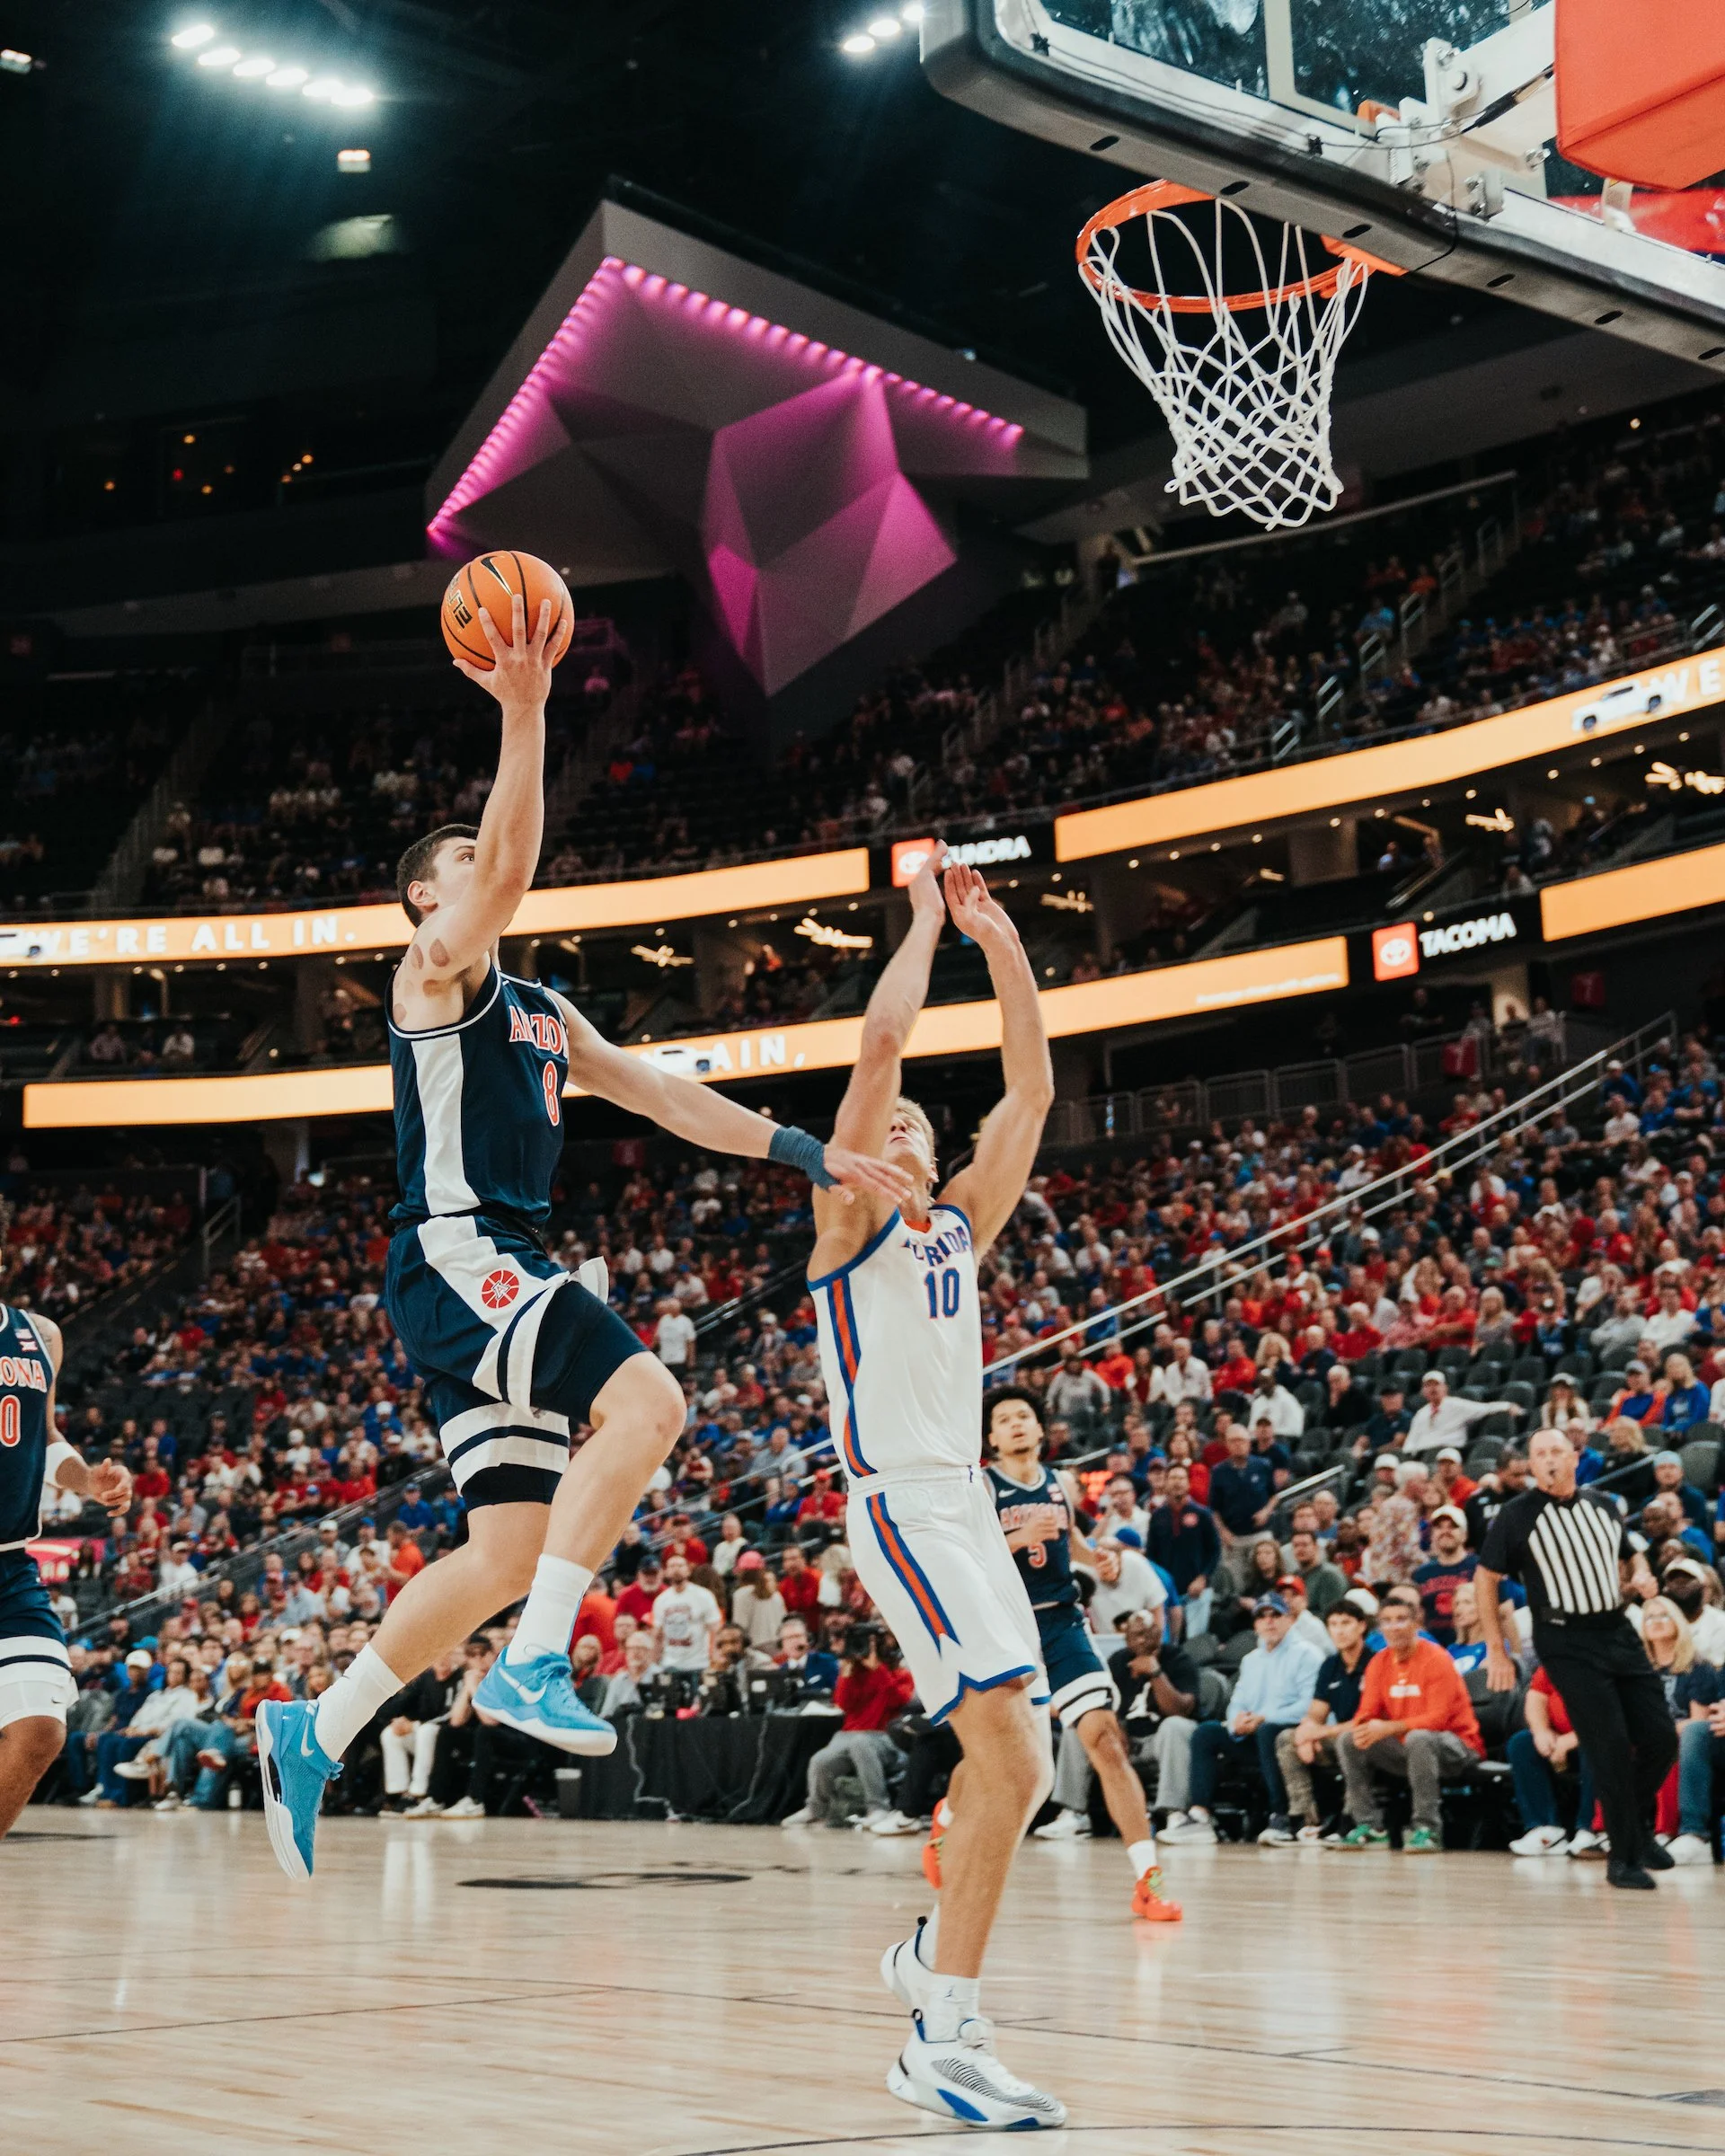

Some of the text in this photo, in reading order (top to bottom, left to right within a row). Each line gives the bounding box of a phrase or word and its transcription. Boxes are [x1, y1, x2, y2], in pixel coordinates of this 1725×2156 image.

[191, 923, 270, 953] ALL
[293, 915, 357, 947] IN.
[1419, 912, 1517, 959] TACOMA
[543, 1060, 560, 1127] 8
[924, 1268, 960, 1319] 10
[0, 1356, 48, 1393] ONA
[0, 1394, 21, 1447] 0
